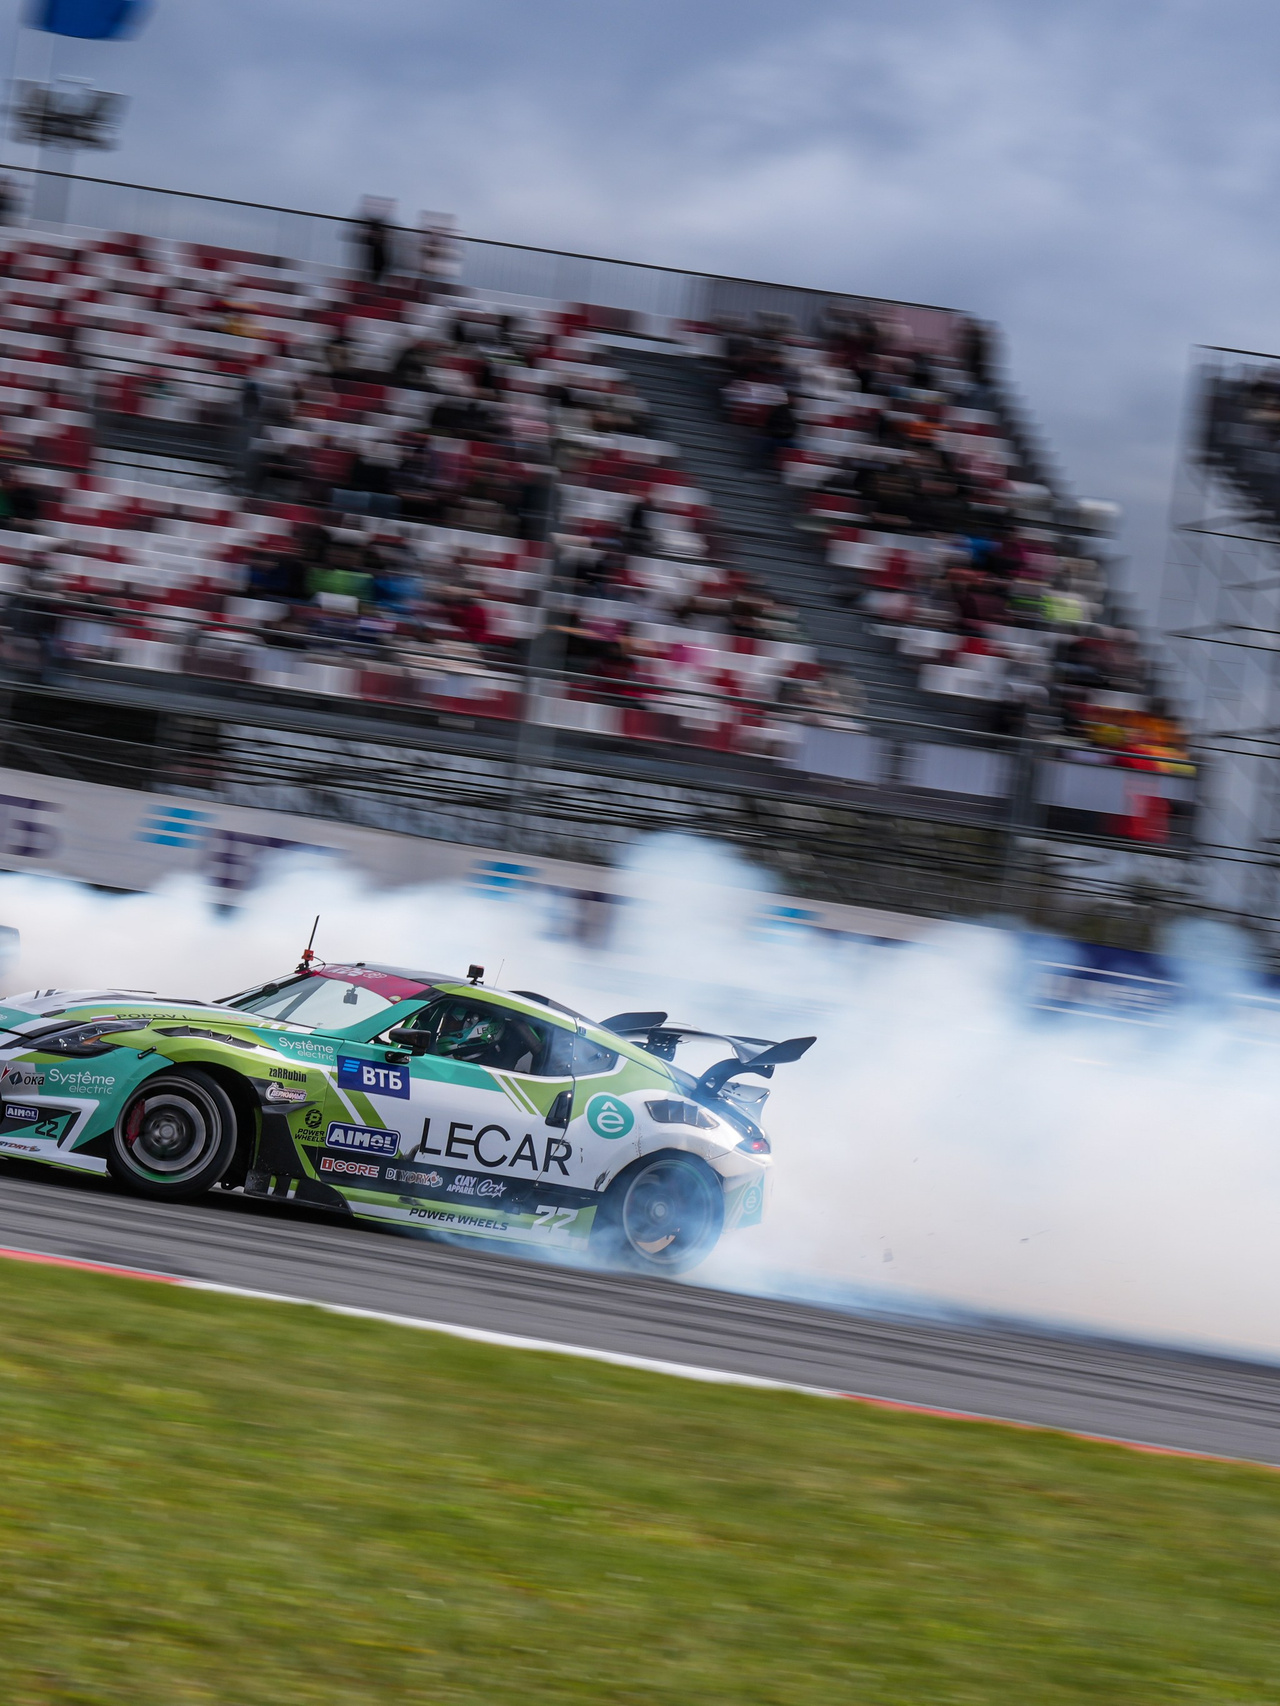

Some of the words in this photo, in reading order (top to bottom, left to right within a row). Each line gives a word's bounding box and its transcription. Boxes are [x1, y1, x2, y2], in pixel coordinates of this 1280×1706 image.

[278, 1037, 334, 1054] Systême
[297, 1050, 334, 1061] electric
[48, 1068, 115, 1085] Systême
[269, 1067, 307, 1082] zaRRubin
[362, 1066, 402, 1090] ВТБ
[69, 1083, 113, 1095] electric
[7, 1107, 37, 1119] AIMOL
[34, 1120, 59, 1138] 22
[297, 1128, 325, 1136] POWER
[294, 1134, 325, 1142] WHEELS
[329, 1128, 394, 1151] AIMOL
[420, 1118, 573, 1176] LECAR
[455, 1174, 476, 1187] CLAY
[446, 1184, 474, 1195] APPAREL
[409, 1208, 456, 1223] POWER
[458, 1216, 509, 1231] WHEELS
[531, 1205, 578, 1233] 22
